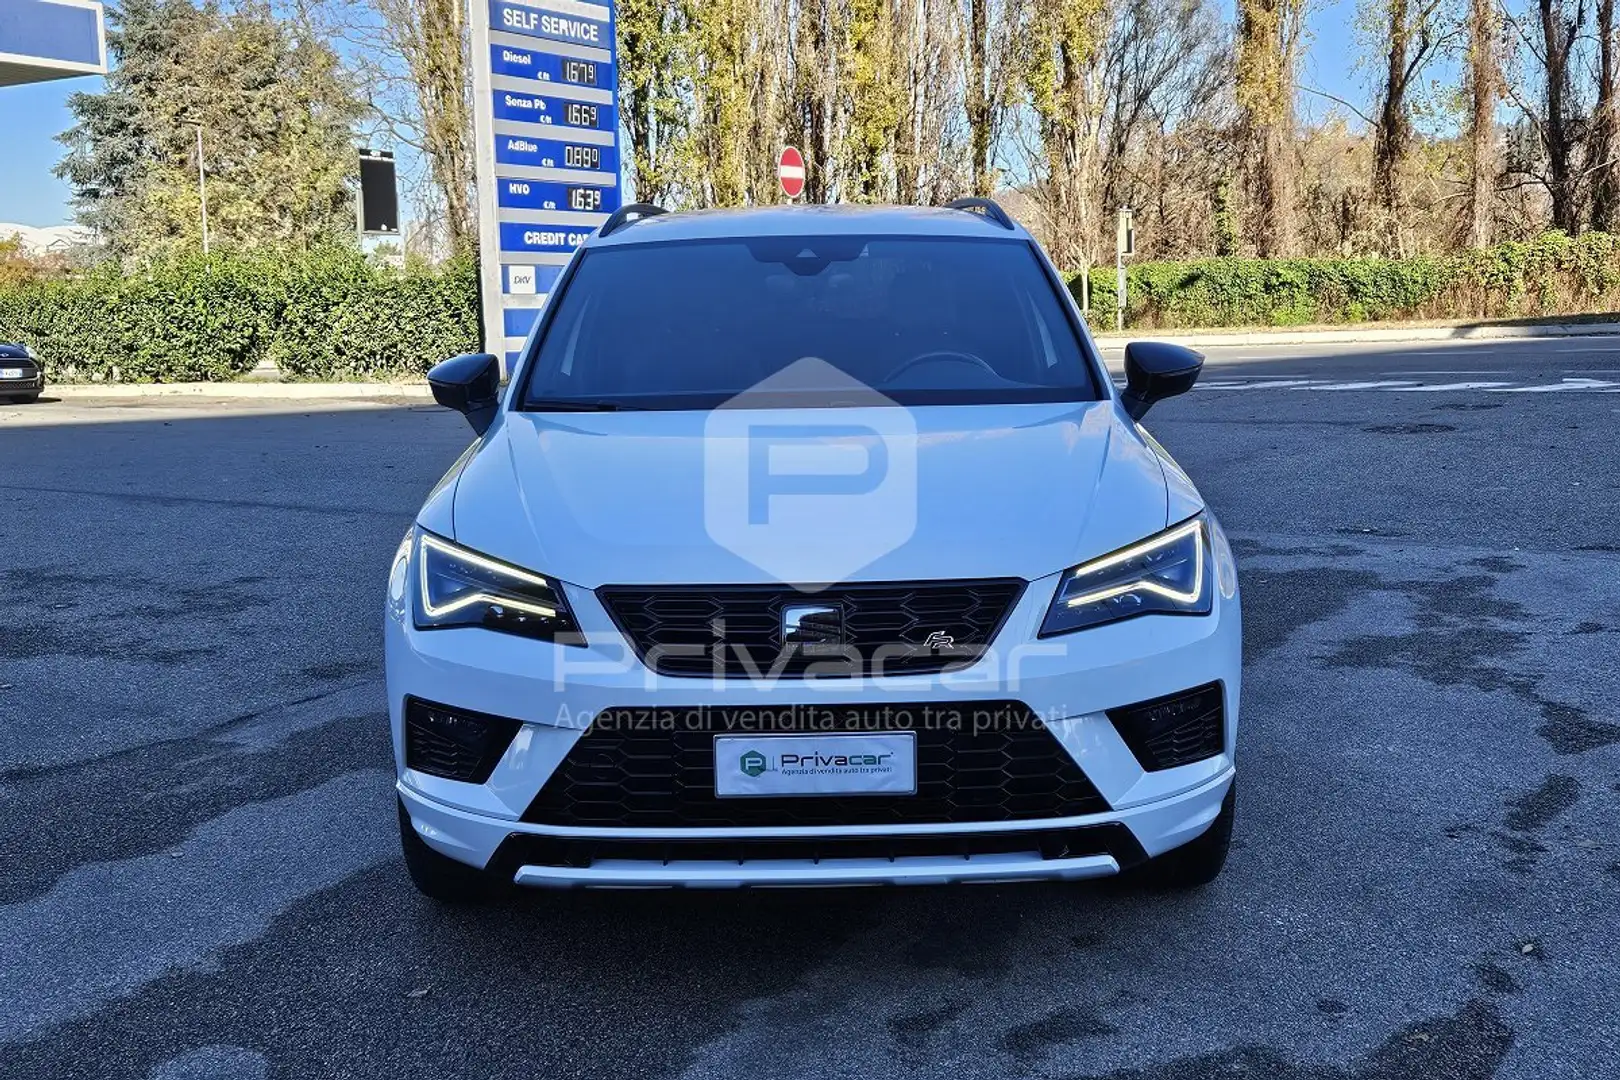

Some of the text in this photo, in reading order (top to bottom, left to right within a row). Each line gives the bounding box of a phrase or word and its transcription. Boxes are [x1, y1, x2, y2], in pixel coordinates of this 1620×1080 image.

[503, 8, 599, 41] SELF SERVICE
[502, 50, 532, 65] Diesel
[505, 94, 547, 111] Senza Pb
[507, 139, 539, 153] AdBlue
[509, 183, 530, 195] HVO
[524, 231, 566, 246] CREDIT
[513, 275, 532, 285] DKV
[781, 751, 891, 767] Privacar
